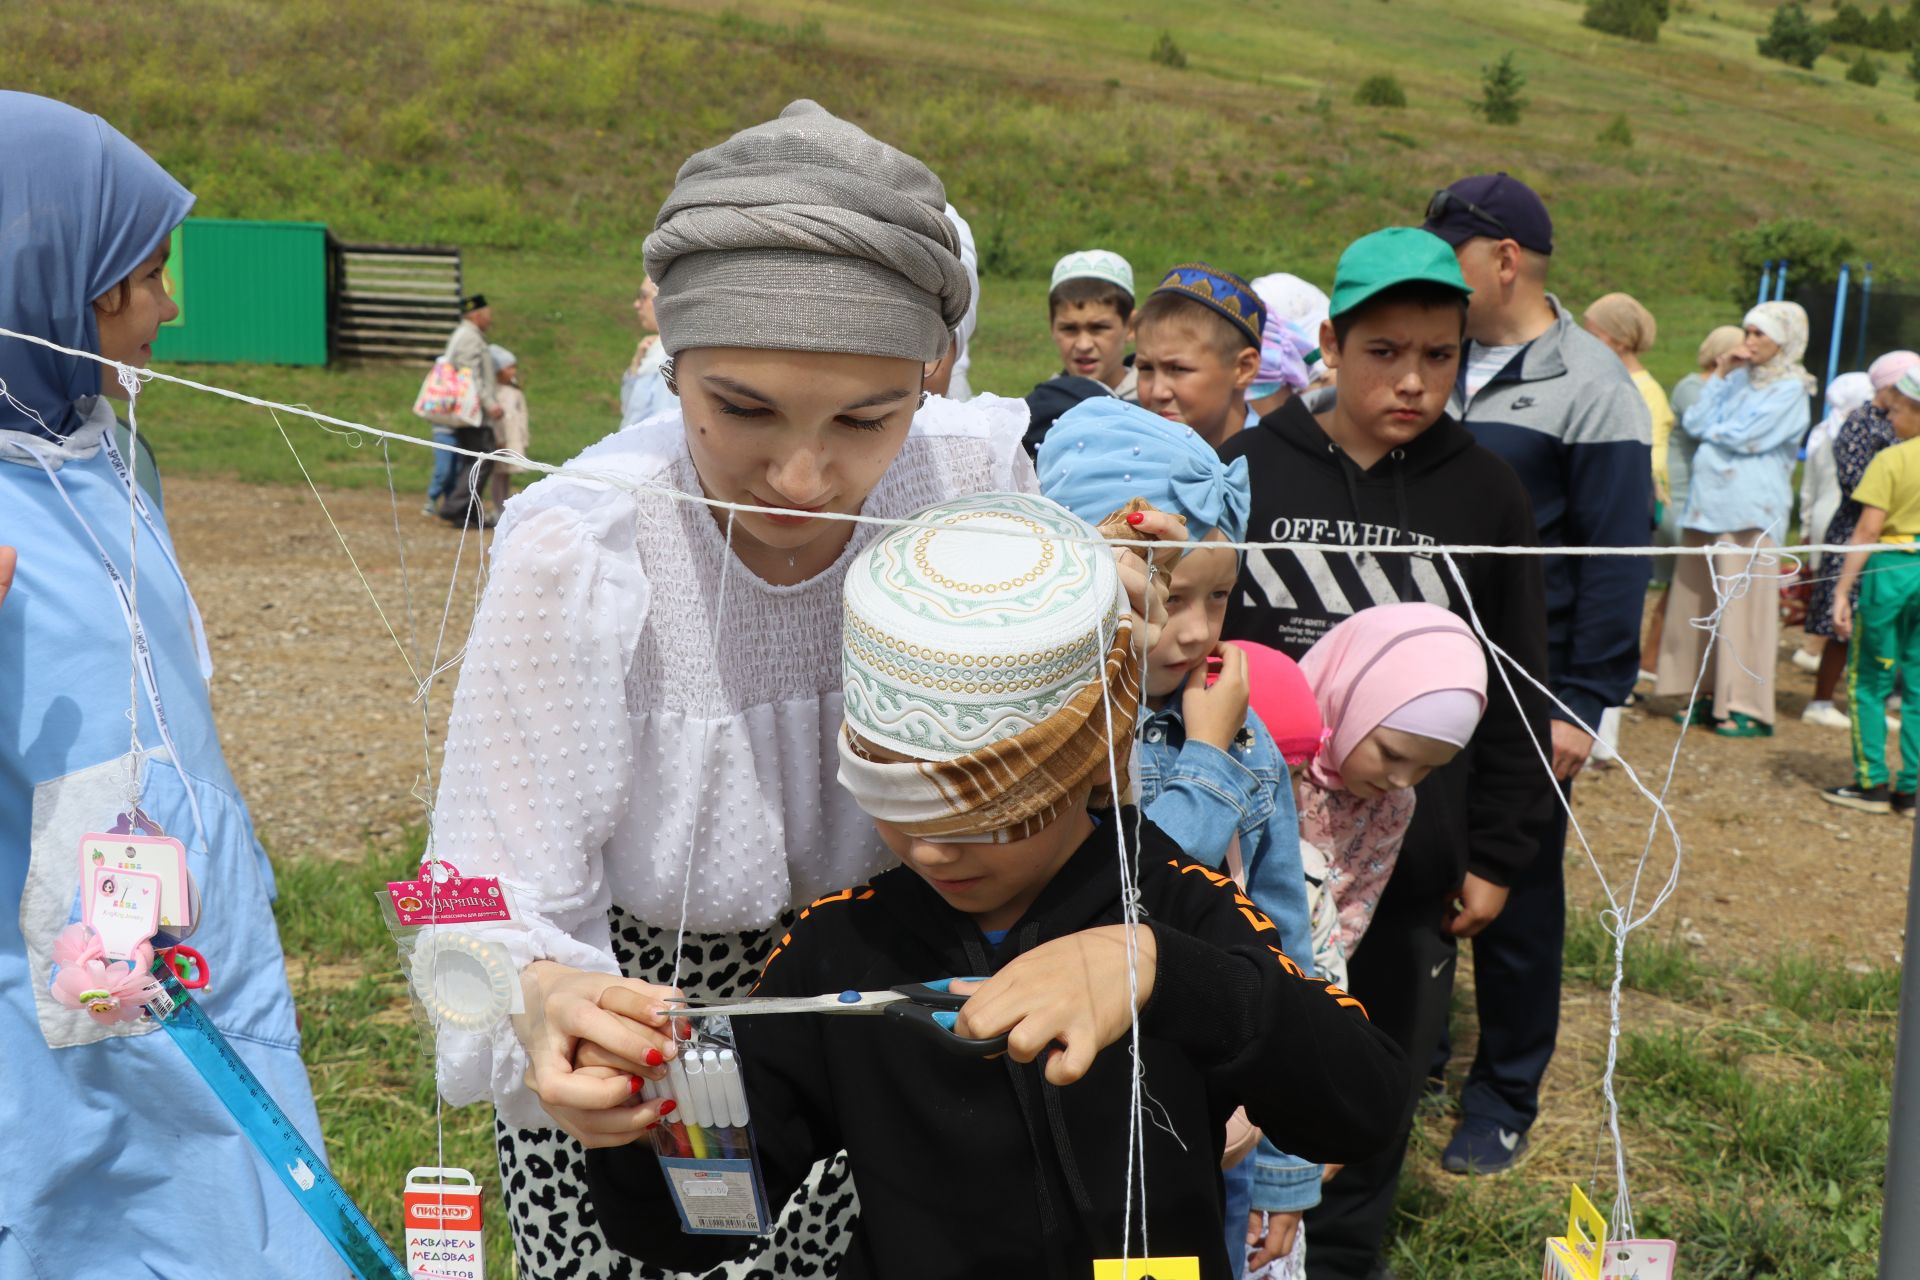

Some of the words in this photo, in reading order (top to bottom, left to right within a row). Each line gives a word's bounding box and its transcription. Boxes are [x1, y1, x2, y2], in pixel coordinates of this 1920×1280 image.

[108, 449, 125, 472] SPORT
[1271, 517, 1435, 559] OFF-WHIE
[415, 1206, 468, 1217] ПИФАГОР
[411, 1238, 475, 1249] АКВАРЕЛЬ
[412, 1251, 475, 1262] МЕДОВАЯ
